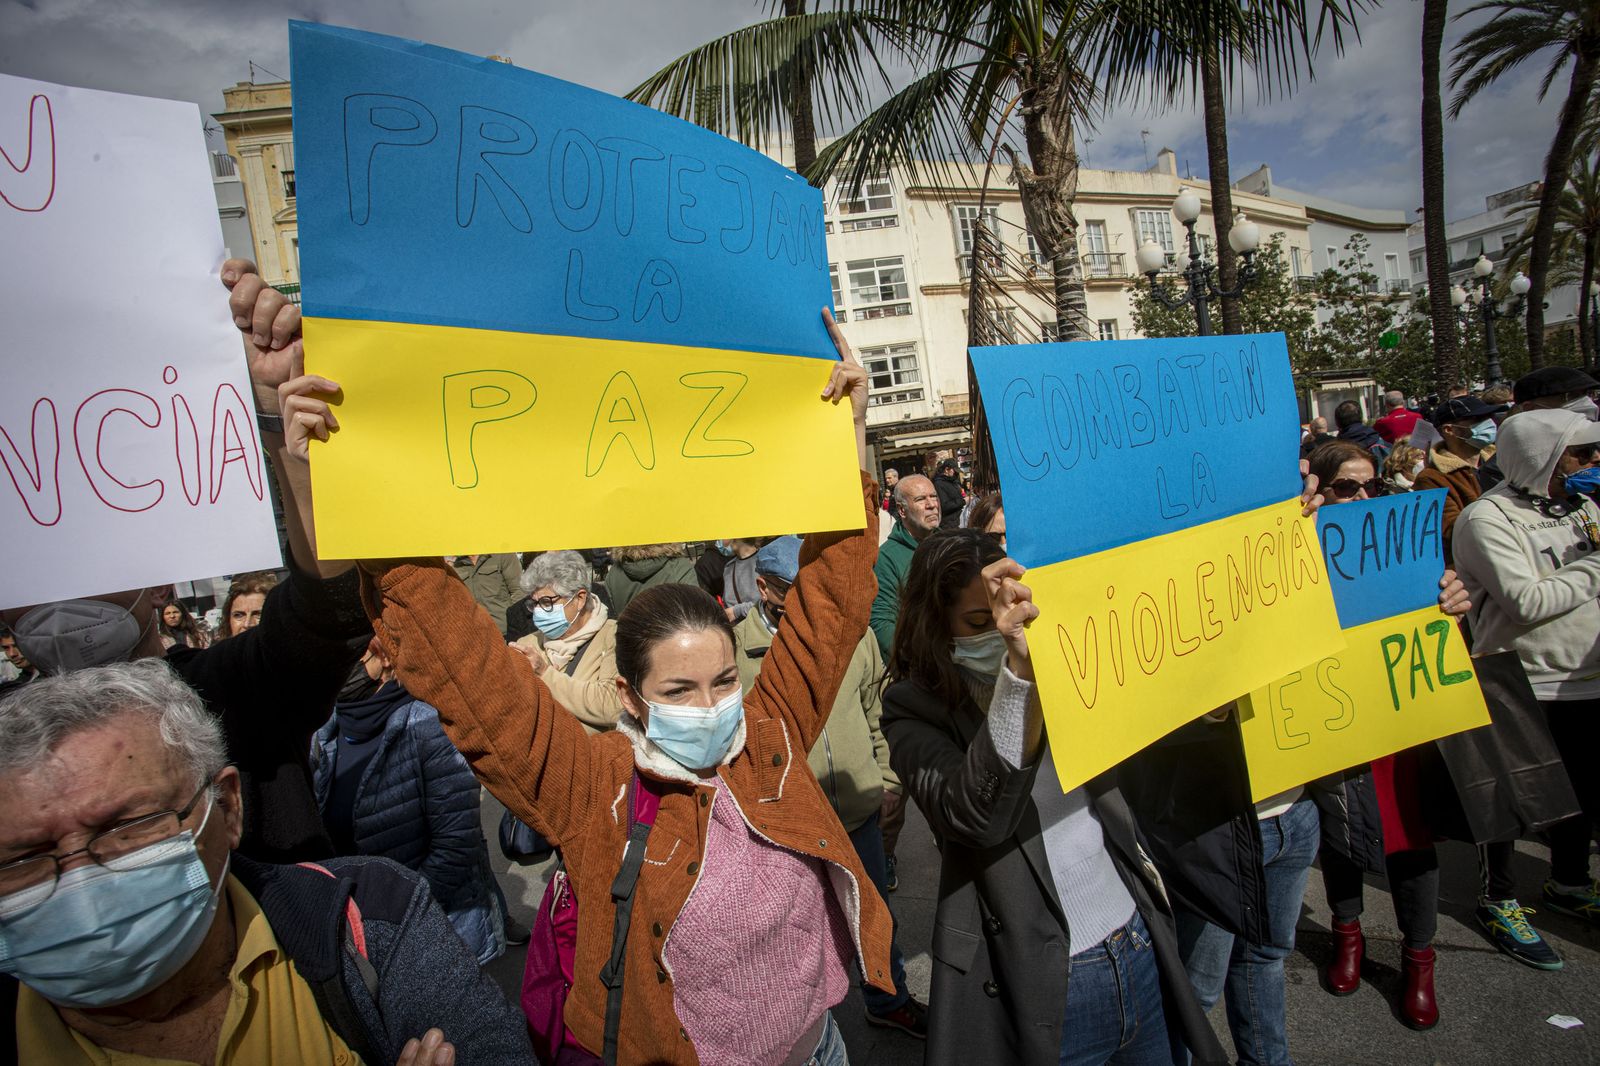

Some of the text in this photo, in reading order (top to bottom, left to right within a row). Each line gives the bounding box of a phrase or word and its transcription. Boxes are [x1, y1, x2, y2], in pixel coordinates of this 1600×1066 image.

[343, 93, 823, 271] PROTEJAN
[564, 248, 683, 324] LA
[442, 369, 755, 490] PAZ
[1002, 341, 1266, 482] COMBATAN
[1155, 451, 1217, 520] LA
[1268, 619, 1474, 751] ES PAZ
